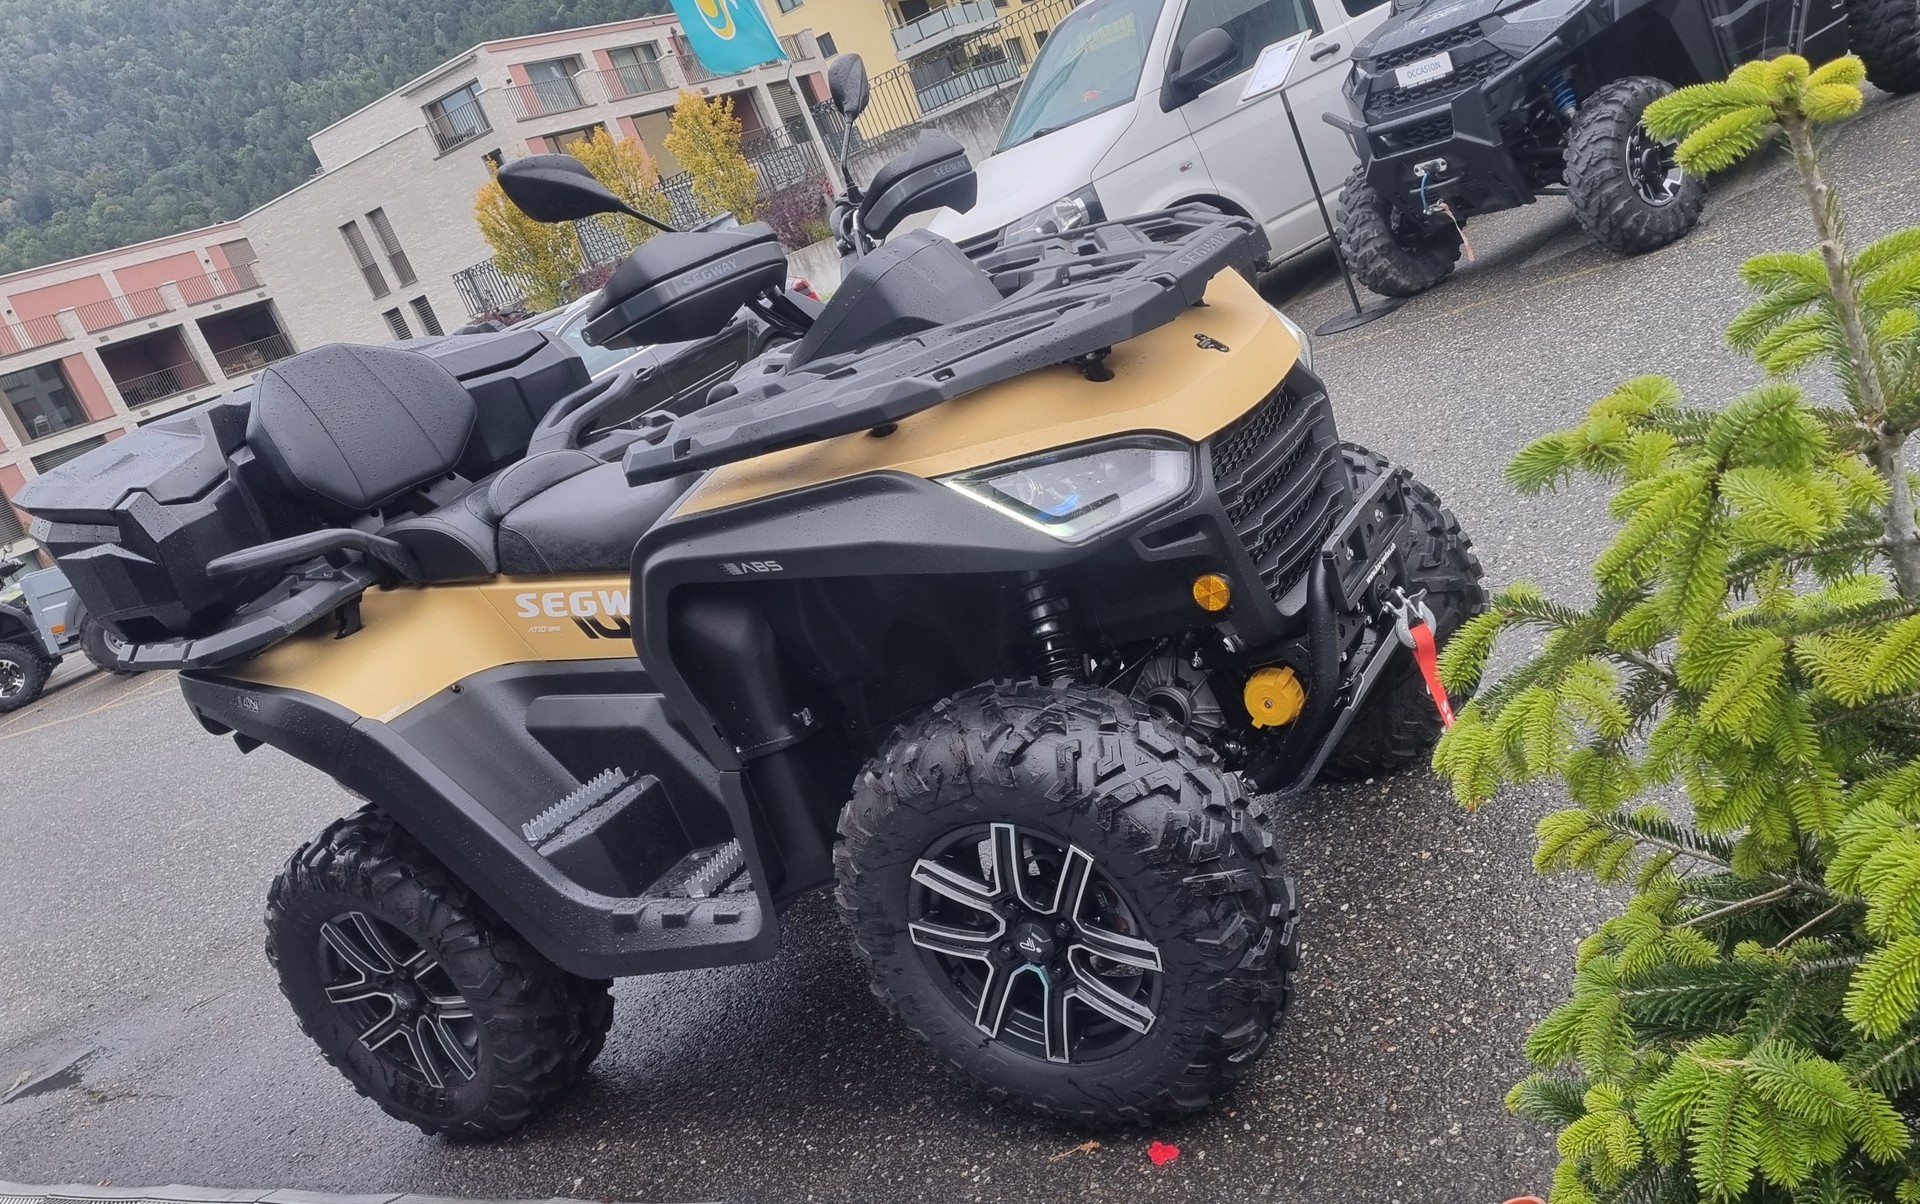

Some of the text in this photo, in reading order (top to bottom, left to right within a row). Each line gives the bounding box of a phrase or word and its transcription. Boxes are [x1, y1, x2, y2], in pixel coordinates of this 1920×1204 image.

[1406, 61, 1442, 79] OCCASION
[933, 159, 966, 177] SEGWAY
[1178, 231, 1226, 267] SEGWAY
[682, 258, 738, 287] SEGWAY
[740, 560, 784, 573] ABS
